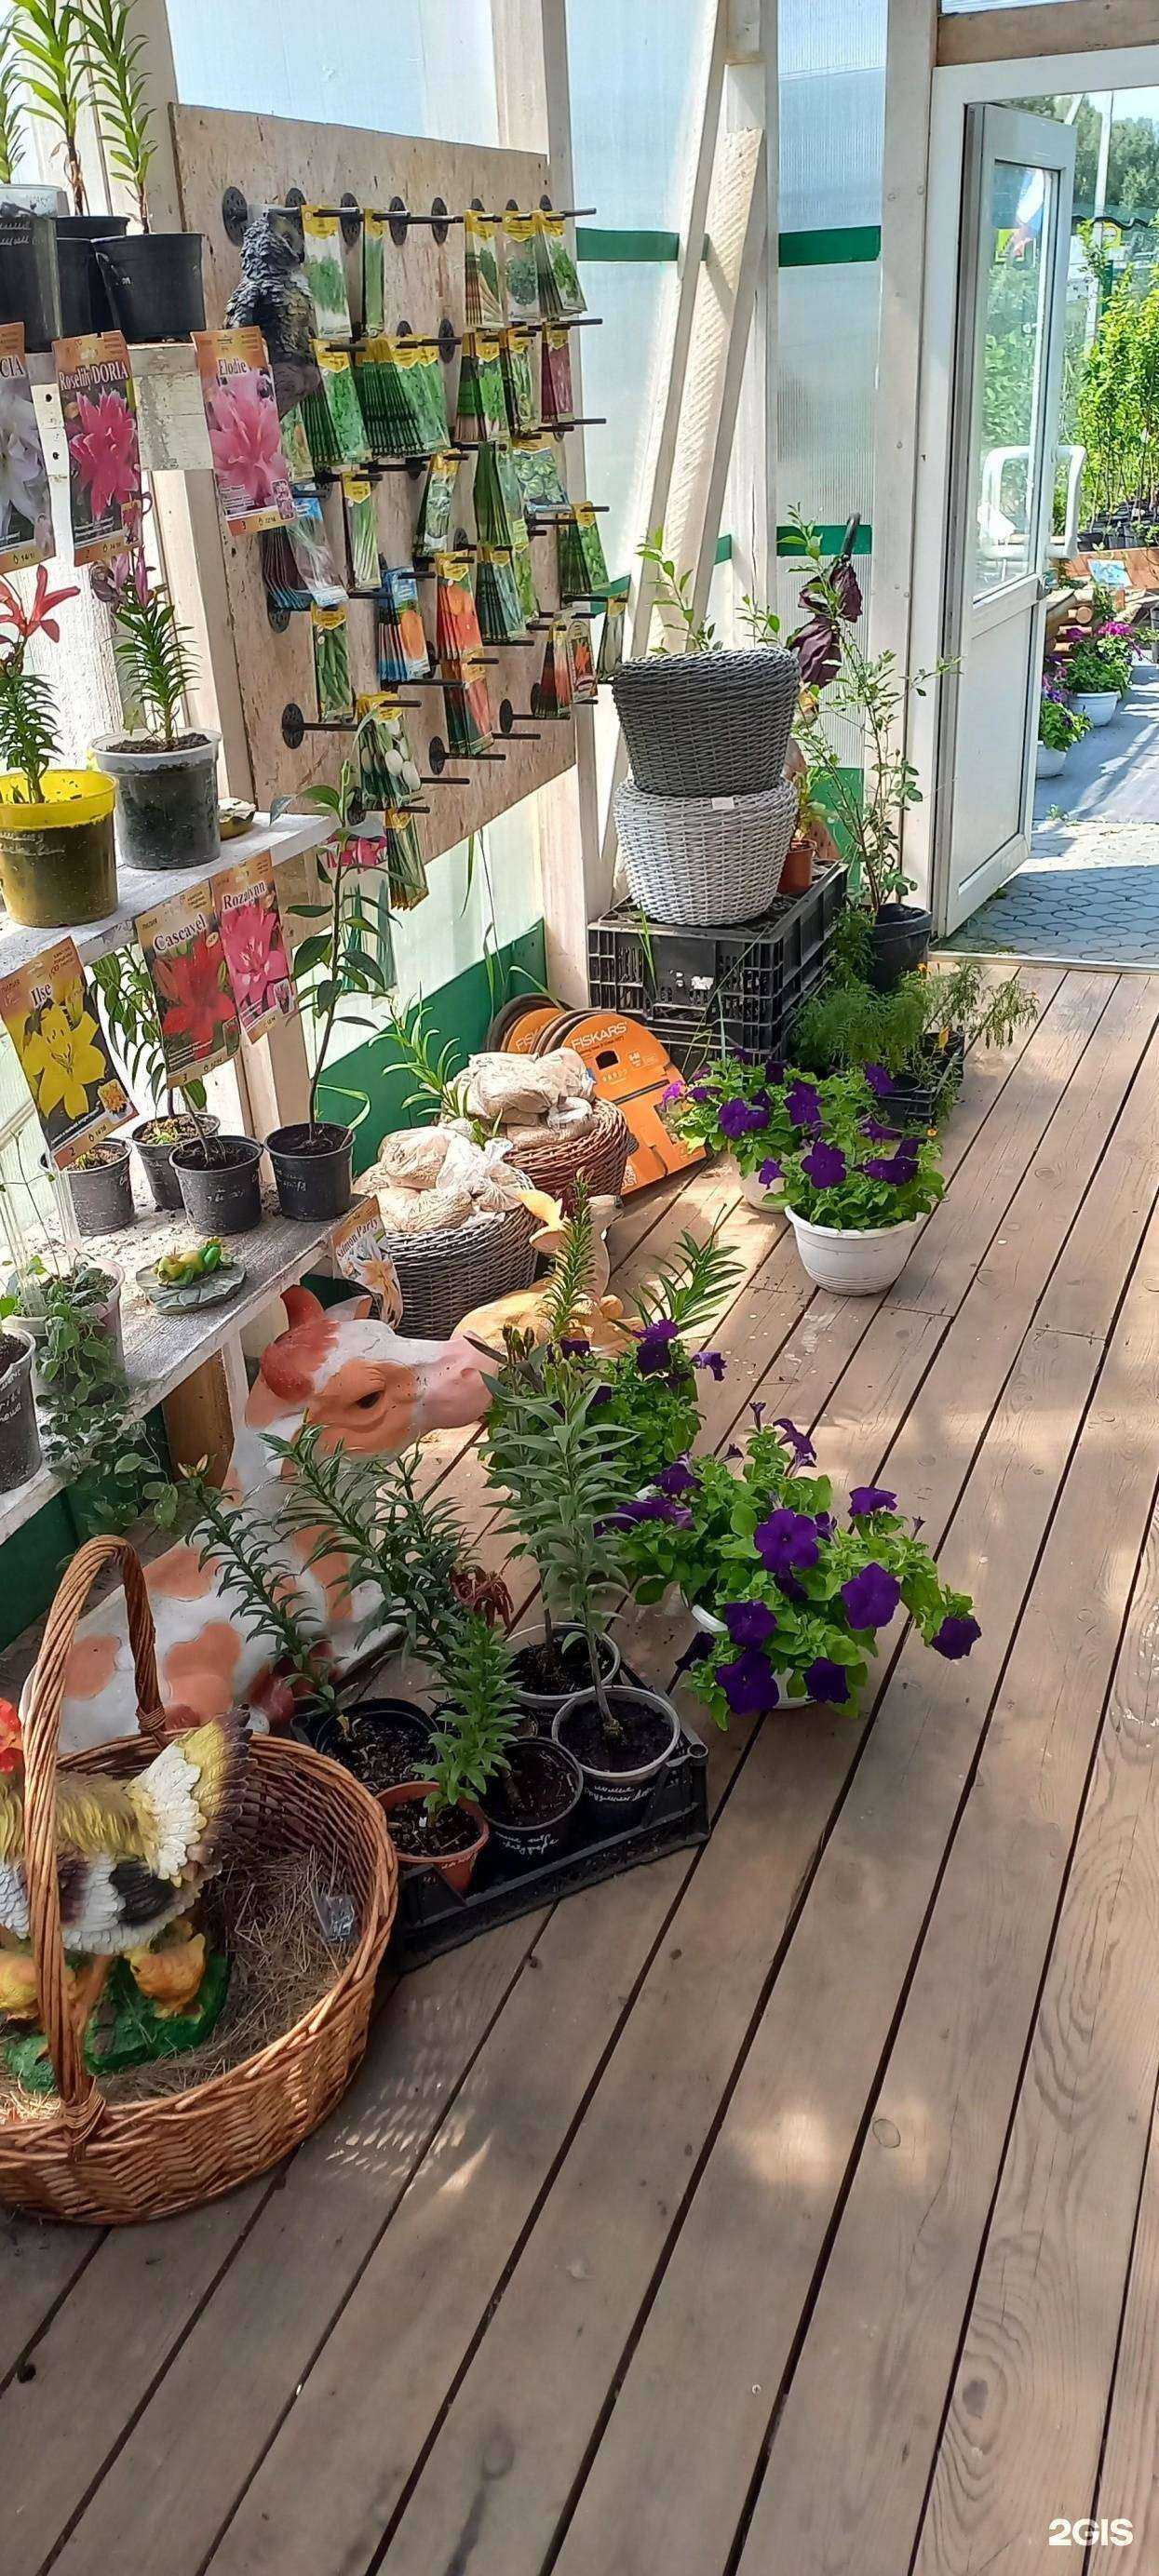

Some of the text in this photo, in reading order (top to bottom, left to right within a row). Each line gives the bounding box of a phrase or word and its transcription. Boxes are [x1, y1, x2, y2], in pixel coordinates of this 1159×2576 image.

[59, 360, 128, 391] Roselily DORIA
[218, 357, 248, 375] Elodie
[223, 881, 265, 909] Rozalynn
[154, 914, 206, 950] Cascavel
[31, 984, 51, 1006] Ilse
[571, 1023, 627, 1050] FISKARS
